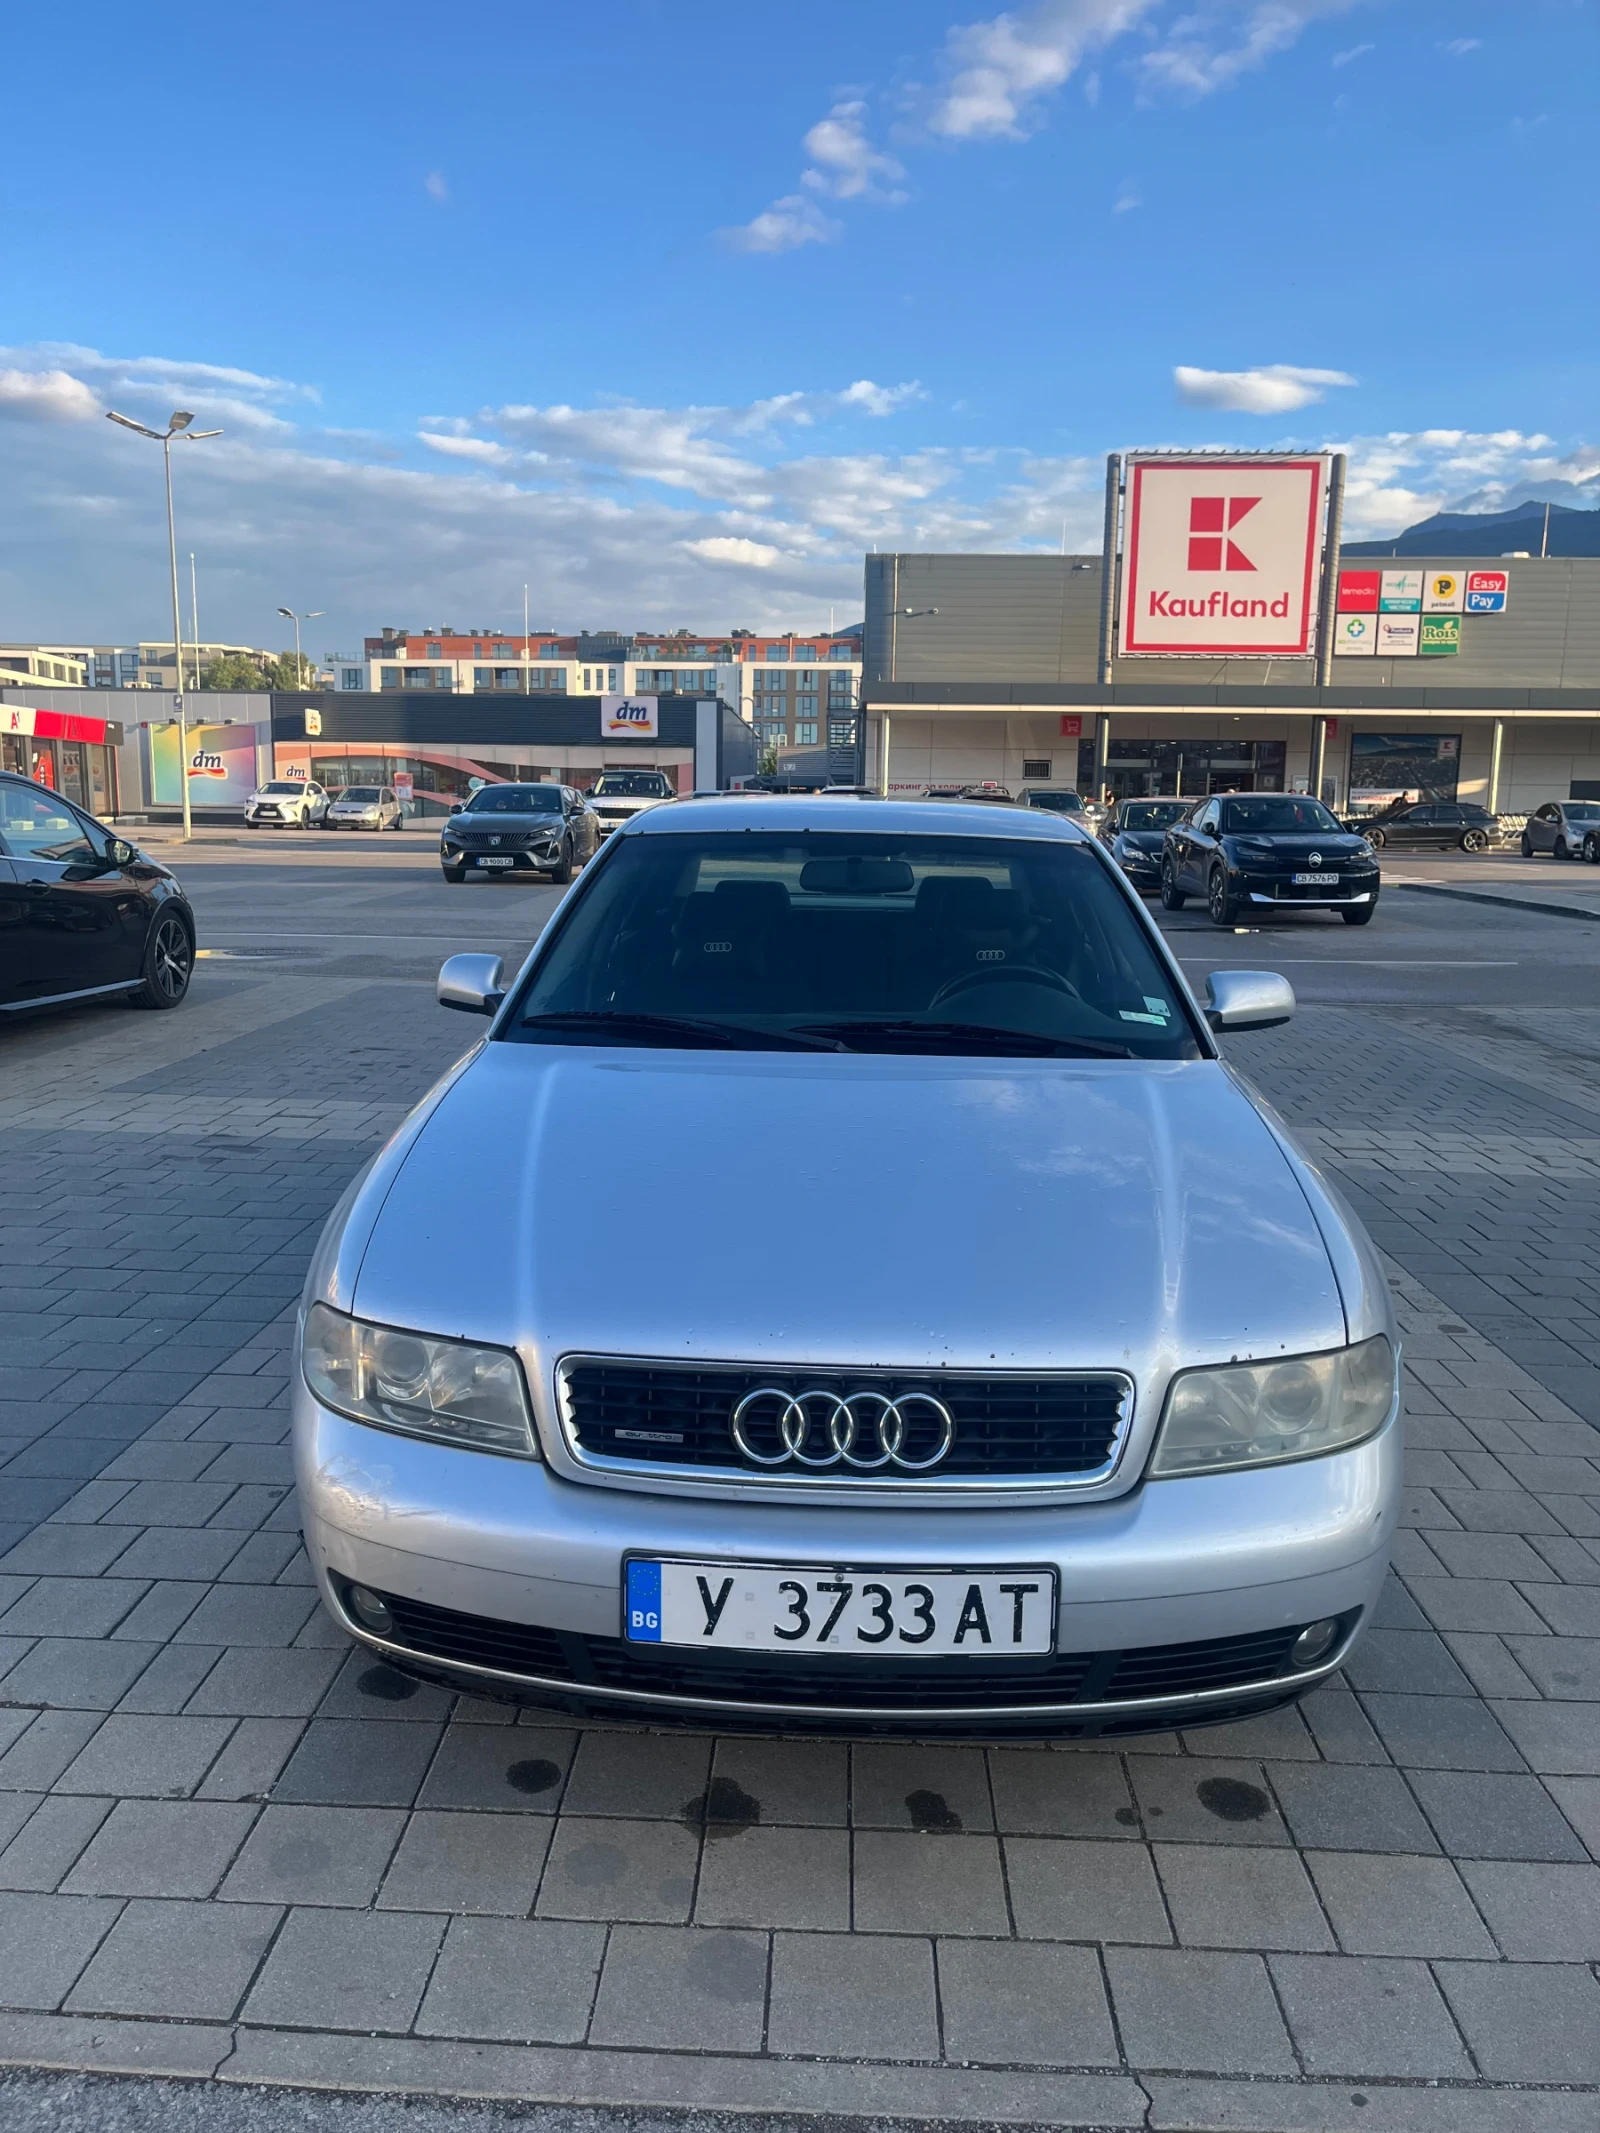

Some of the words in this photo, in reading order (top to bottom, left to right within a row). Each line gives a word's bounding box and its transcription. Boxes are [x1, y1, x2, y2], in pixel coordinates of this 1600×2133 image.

[1473, 577, 1502, 592] Easy
[1149, 591, 1289, 618] Kaufland
[1471, 594, 1494, 609] Pay
[1424, 627, 1457, 639] Rois
[616, 702, 647, 720] dm
[193, 751, 221, 768] dm
[286, 765, 305, 777] dm
[888, 783, 922, 792] аркинг
[631, 1610, 659, 1630] BG
[773, 1580, 936, 1644] 3733
[953, 1582, 1039, 1644] AT
